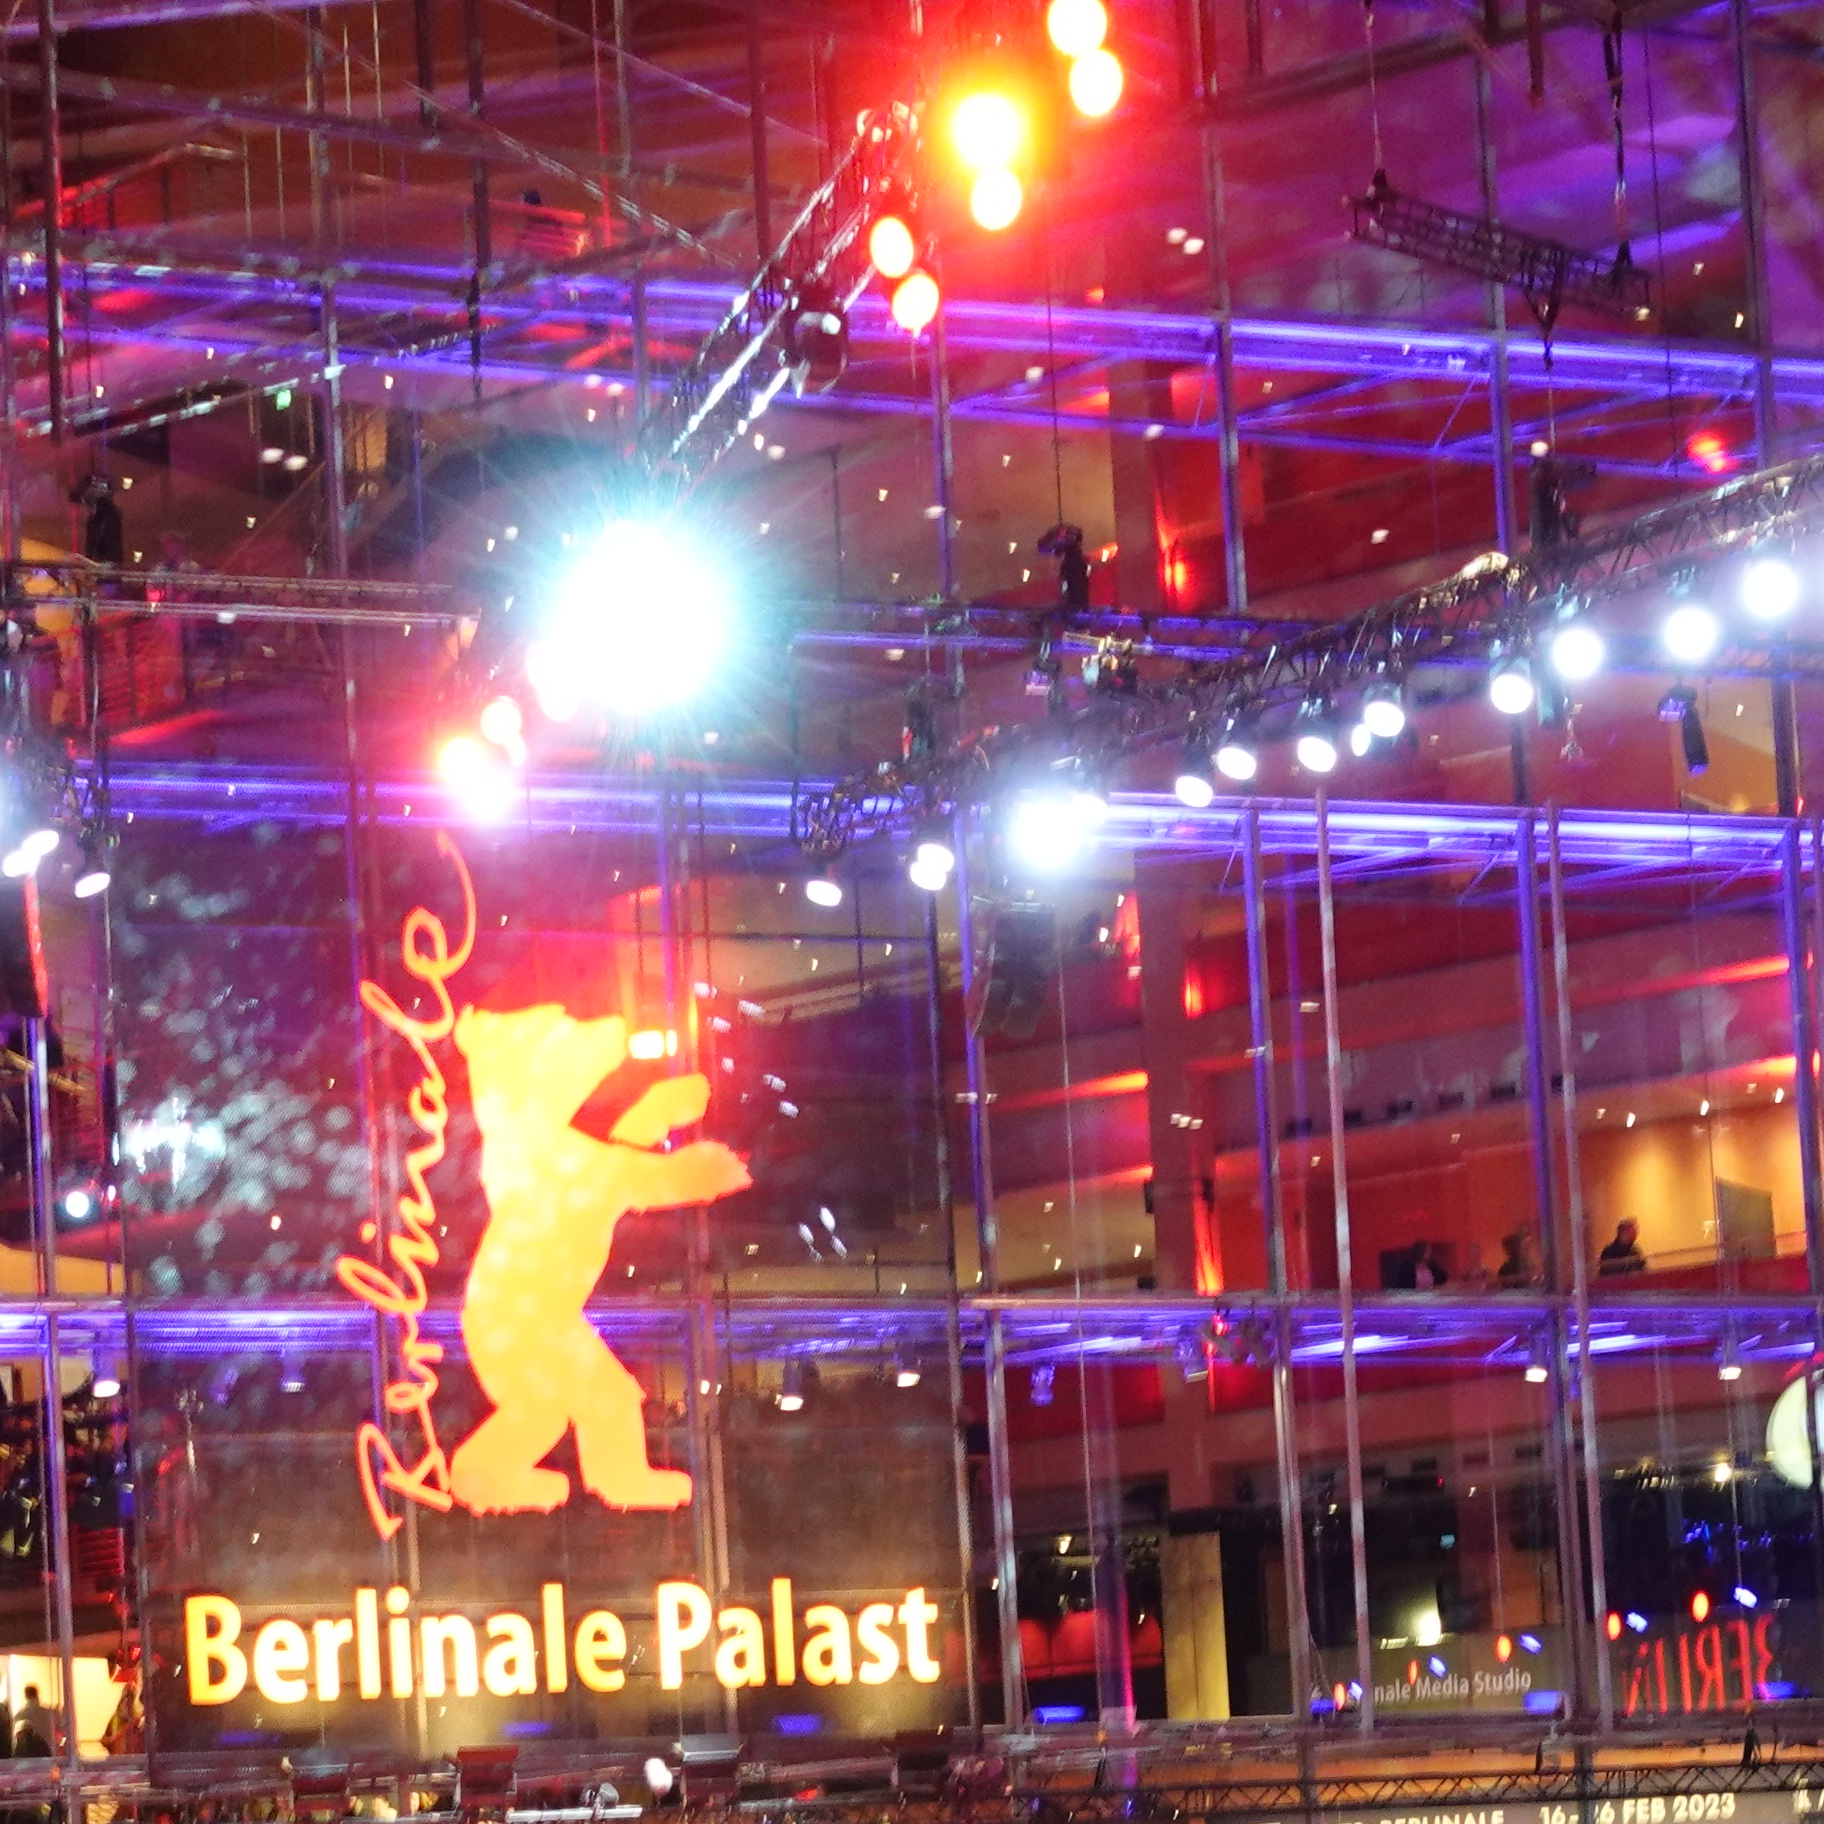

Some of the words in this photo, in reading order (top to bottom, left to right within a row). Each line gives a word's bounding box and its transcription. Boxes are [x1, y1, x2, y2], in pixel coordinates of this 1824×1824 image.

[336, 828, 477, 1541] Berlinale
[184, 1582, 628, 1706] Berlinale
[656, 1577, 942, 1691] Palast
[1416, 1673, 1470, 1701] Media
[1475, 1667, 1532, 1697] Studio
[1672, 1792, 1737, 1823] 2023
